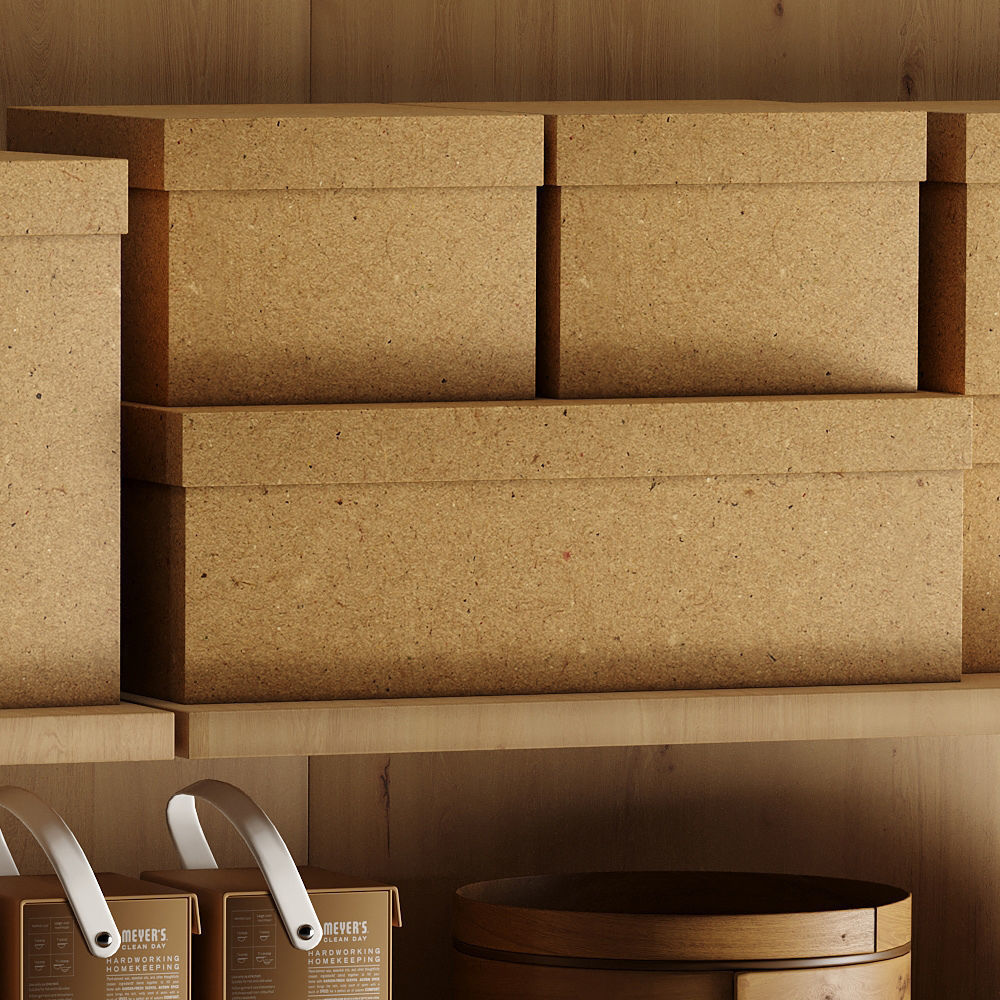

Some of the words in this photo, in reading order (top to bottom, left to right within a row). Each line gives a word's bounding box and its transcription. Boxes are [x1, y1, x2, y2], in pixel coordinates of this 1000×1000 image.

[323, 921, 367, 935] MEYER'S
[122, 928, 166, 943] MEYER'S
[308, 948, 381, 956] HARDWORKING
[106, 955, 180, 964] HARDWORKING
[308, 956, 381, 965] HOMEKEEPING
[106, 964, 180, 972] HOMEKEEPING
